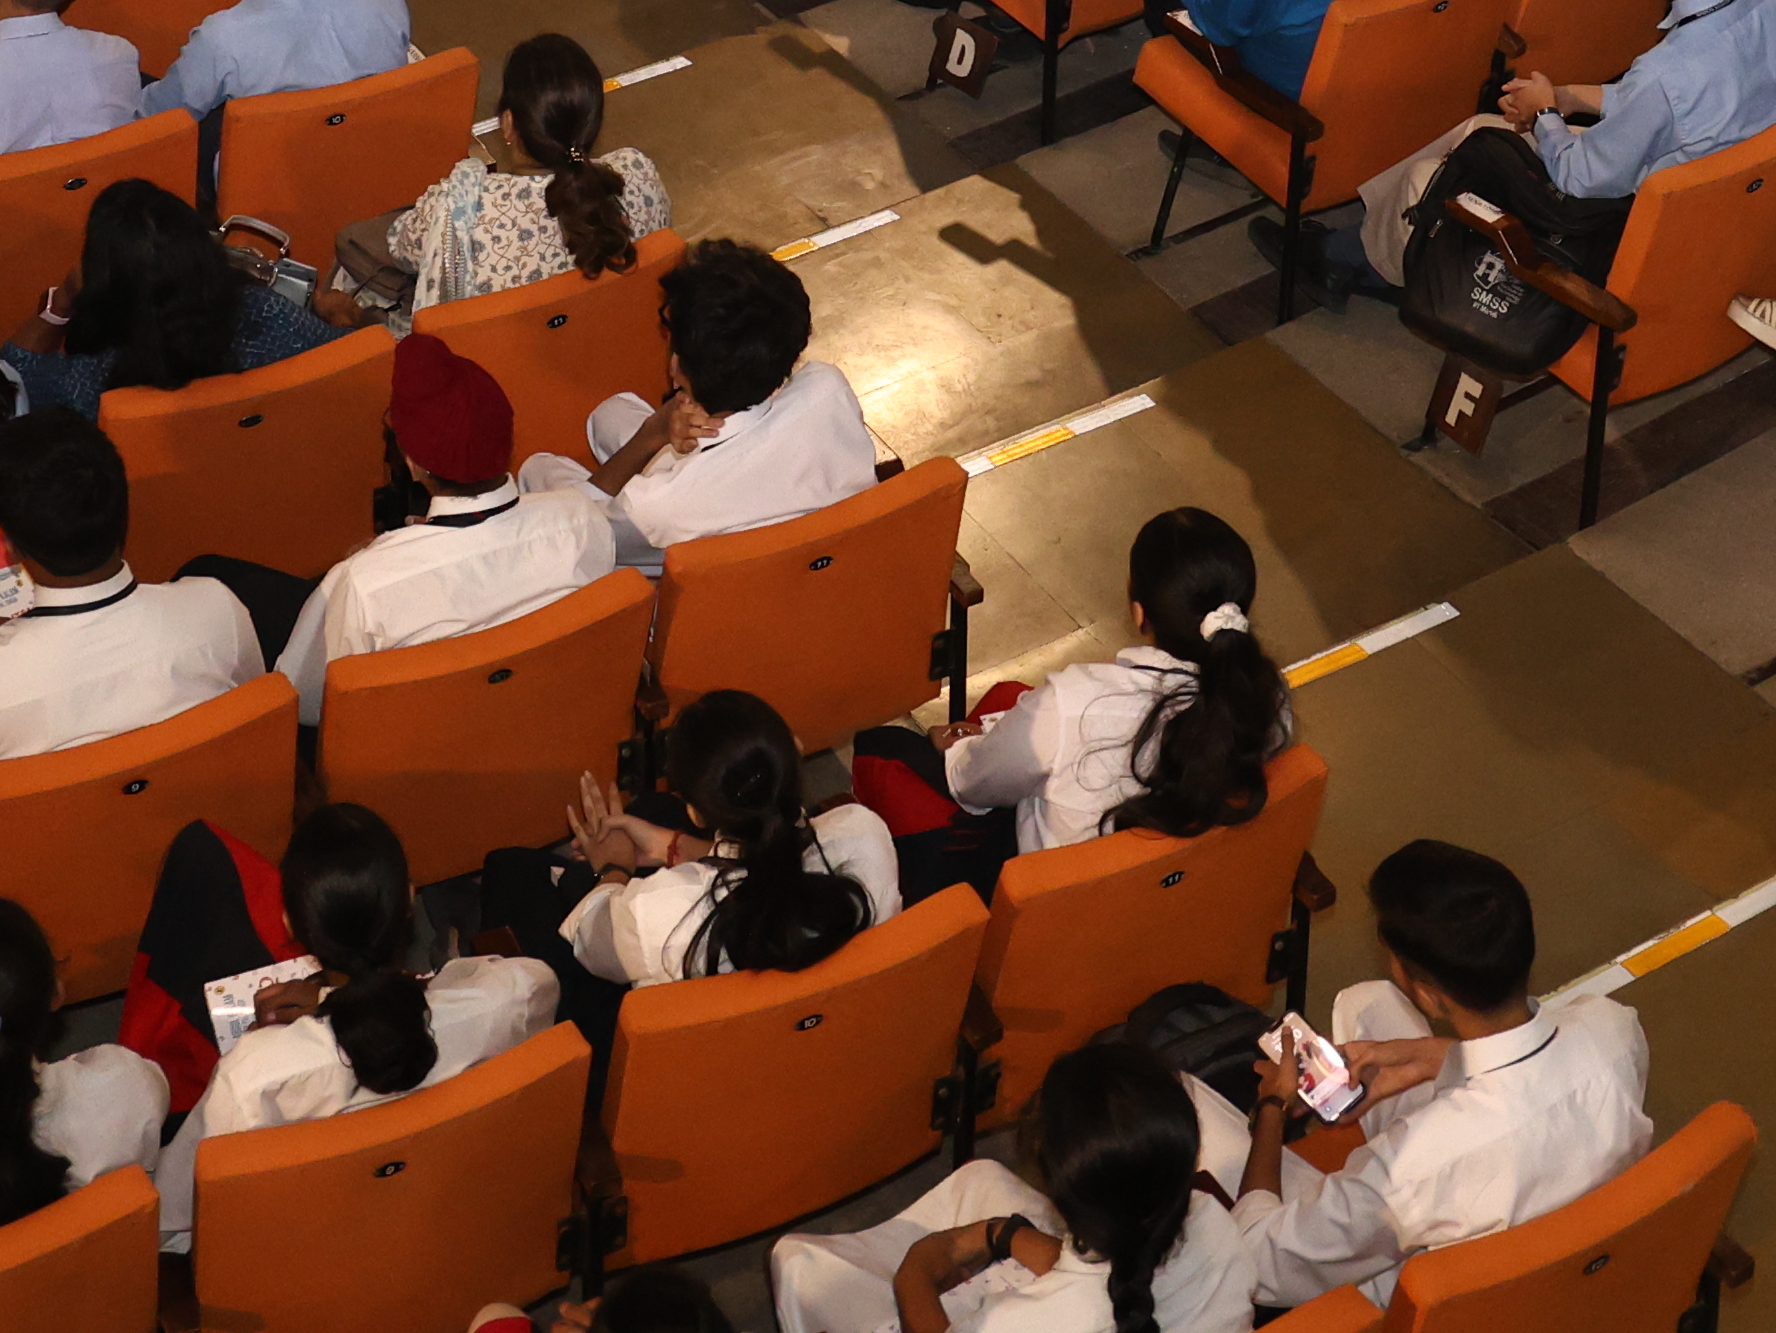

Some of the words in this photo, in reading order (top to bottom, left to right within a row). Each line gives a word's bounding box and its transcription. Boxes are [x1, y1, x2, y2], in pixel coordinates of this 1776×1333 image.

[947, 29, 976, 78] D
[1471, 287, 1510, 313] SMSS
[1445, 372, 1484, 428] F
